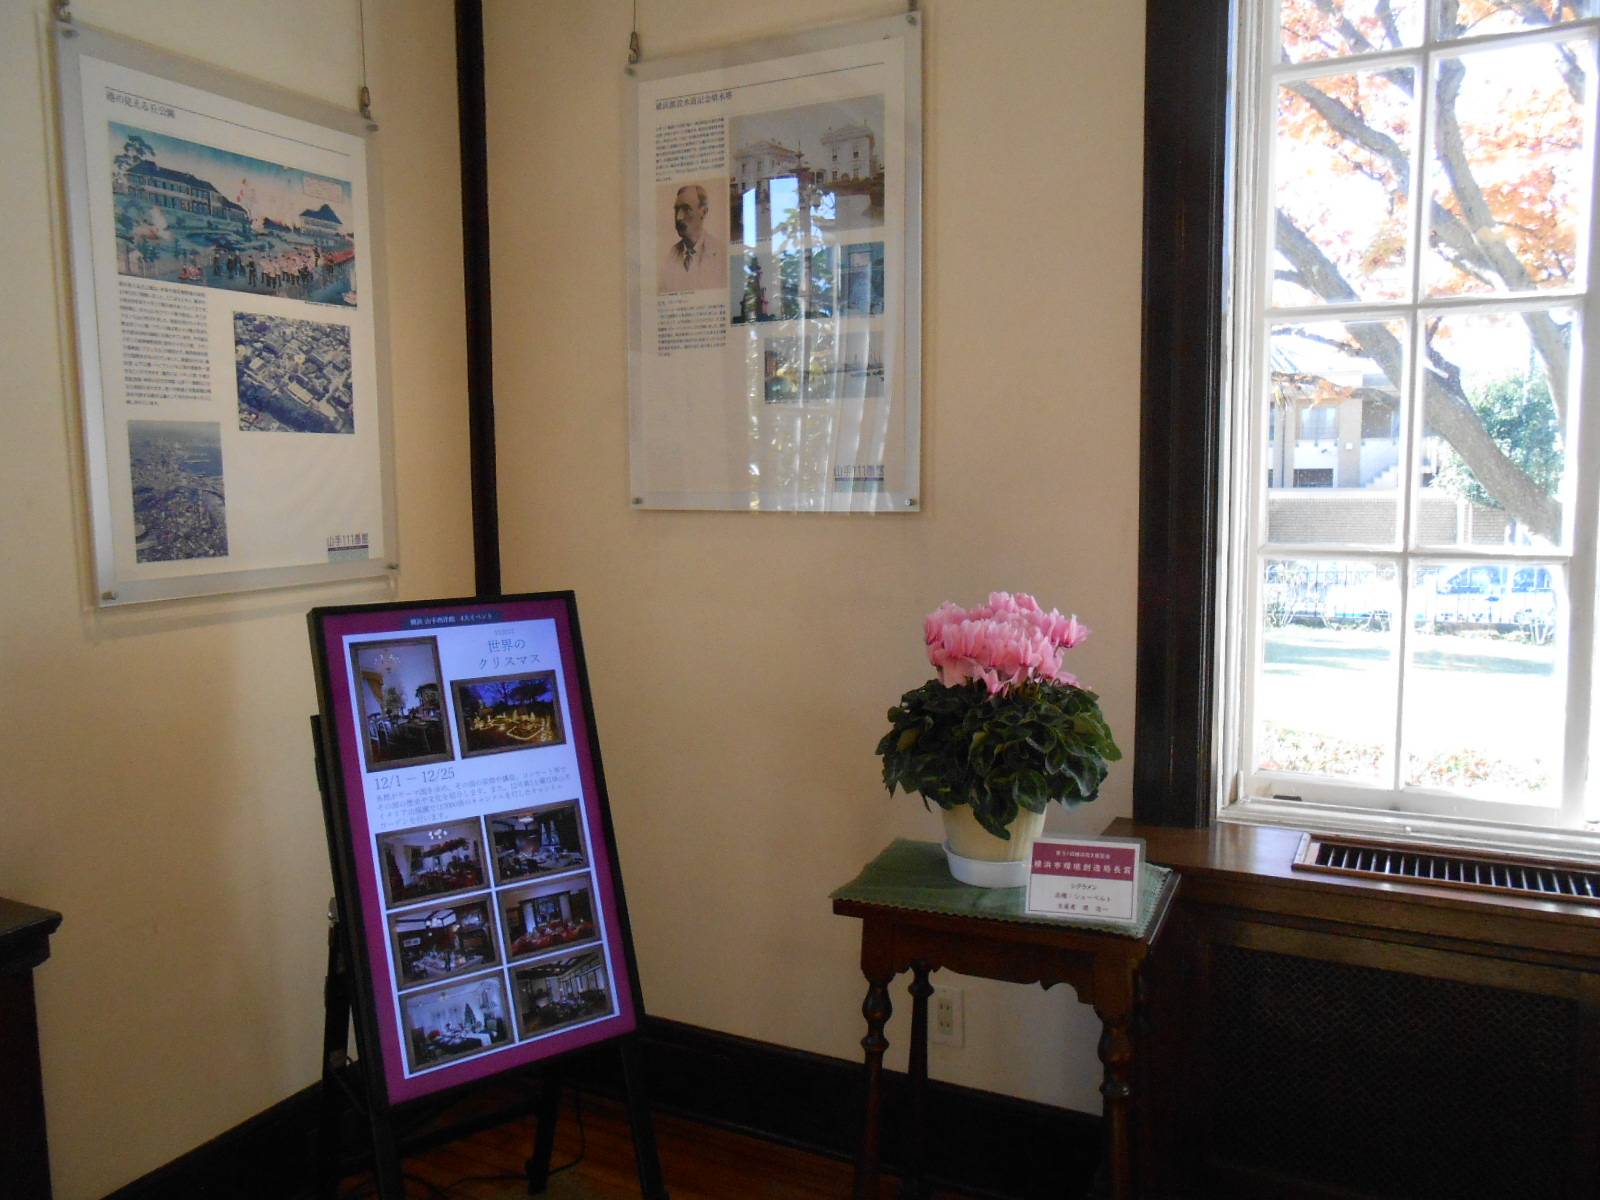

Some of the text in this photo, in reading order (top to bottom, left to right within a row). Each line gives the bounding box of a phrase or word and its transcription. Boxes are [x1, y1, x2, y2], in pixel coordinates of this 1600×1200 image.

[488, 638, 526, 653] 世界の
[480, 654, 541, 670] クリスマス
[375, 775, 401, 790] 12/1
[422, 767, 455, 783] 12/25
